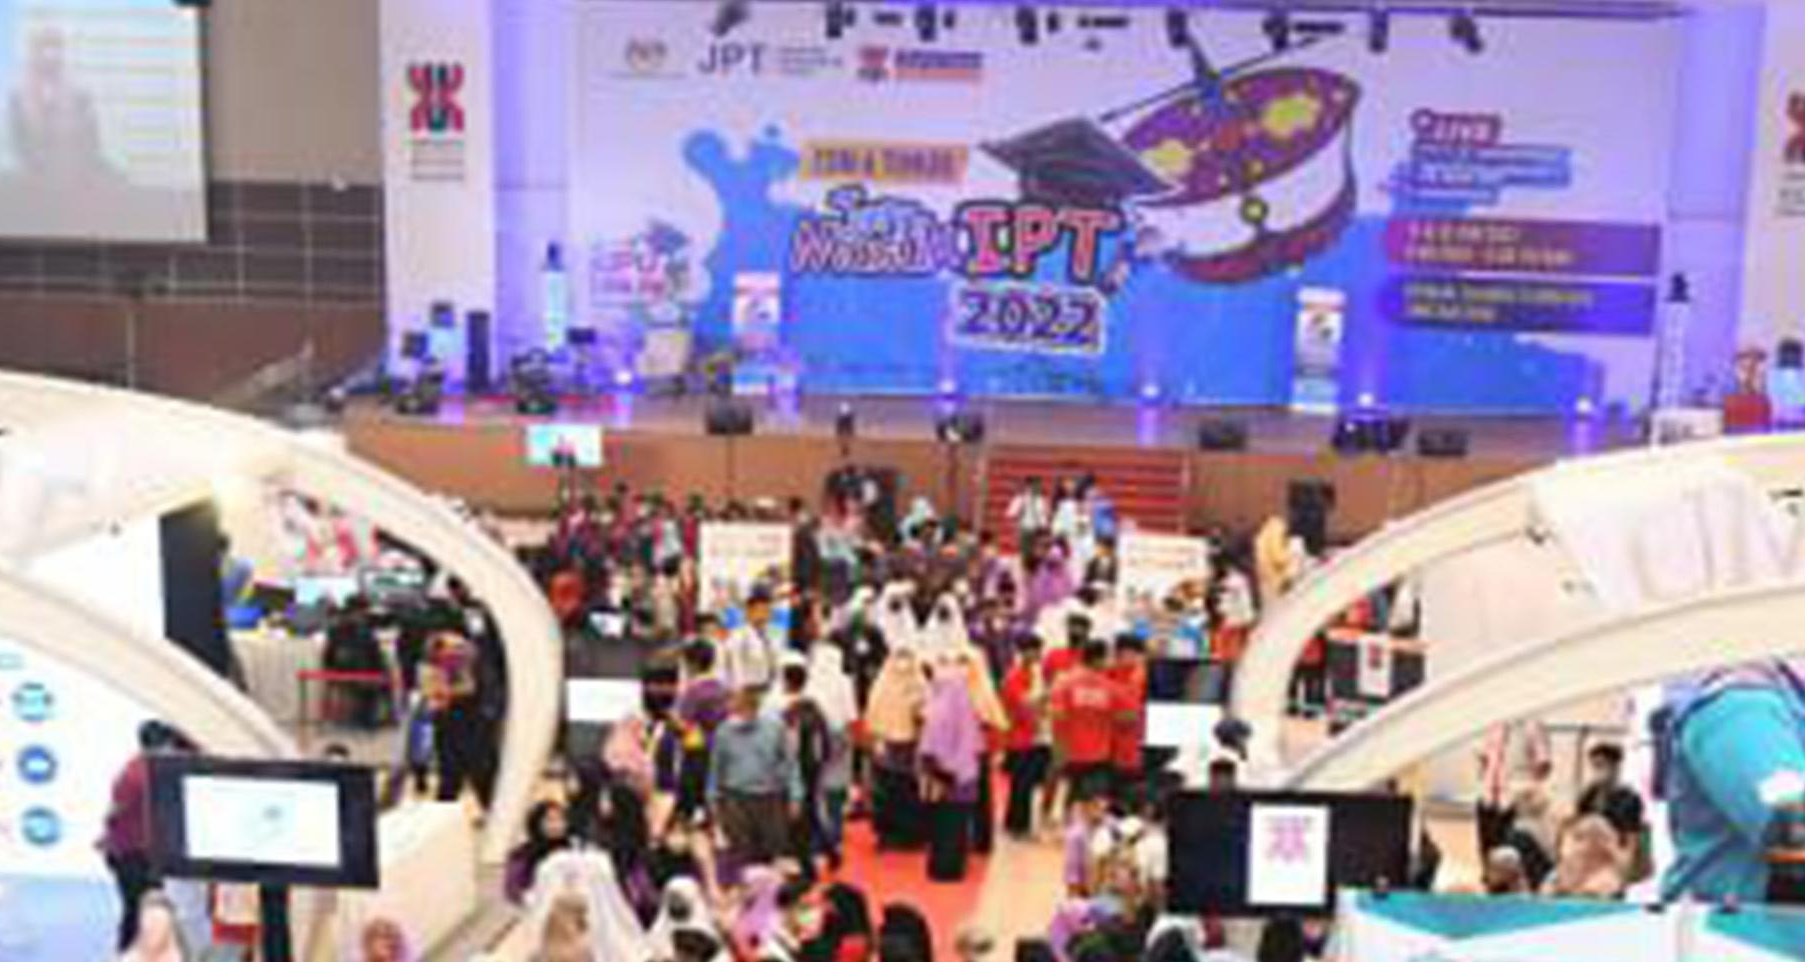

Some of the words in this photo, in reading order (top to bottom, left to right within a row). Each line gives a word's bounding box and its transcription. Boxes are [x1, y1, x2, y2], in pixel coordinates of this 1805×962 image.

[699, 43, 766, 74] JPT
[957, 202, 1123, 286] IPT
[956, 288, 1100, 348] 2022
